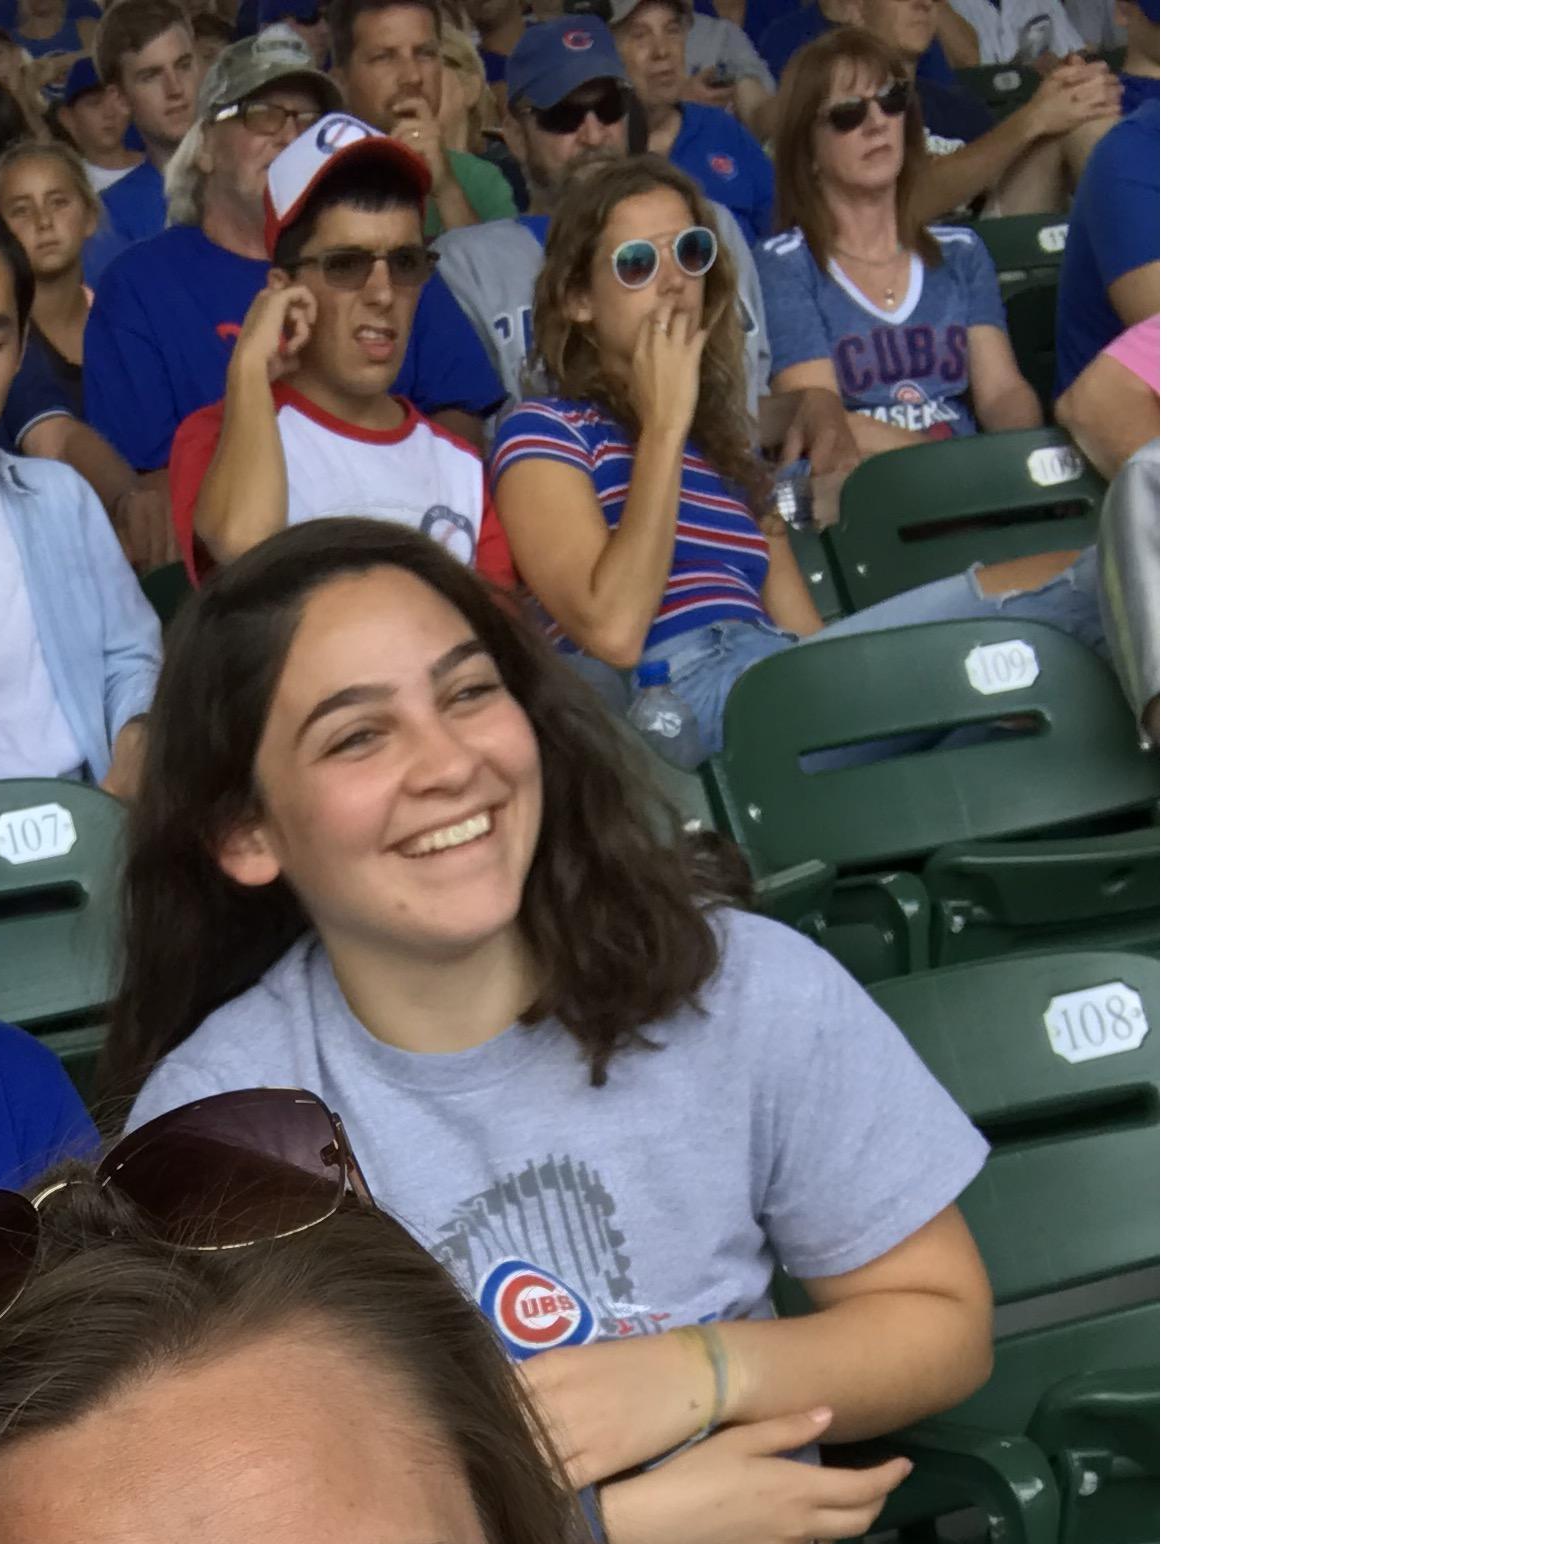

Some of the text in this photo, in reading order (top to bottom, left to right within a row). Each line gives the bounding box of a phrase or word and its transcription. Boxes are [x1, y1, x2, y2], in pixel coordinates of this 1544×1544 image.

[834, 323, 969, 397] CUBS
[977, 647, 1028, 687] 109
[5, 812, 59, 856] 107
[1060, 994, 1134, 1051] 108
[499, 1273, 576, 1344] CUBS
